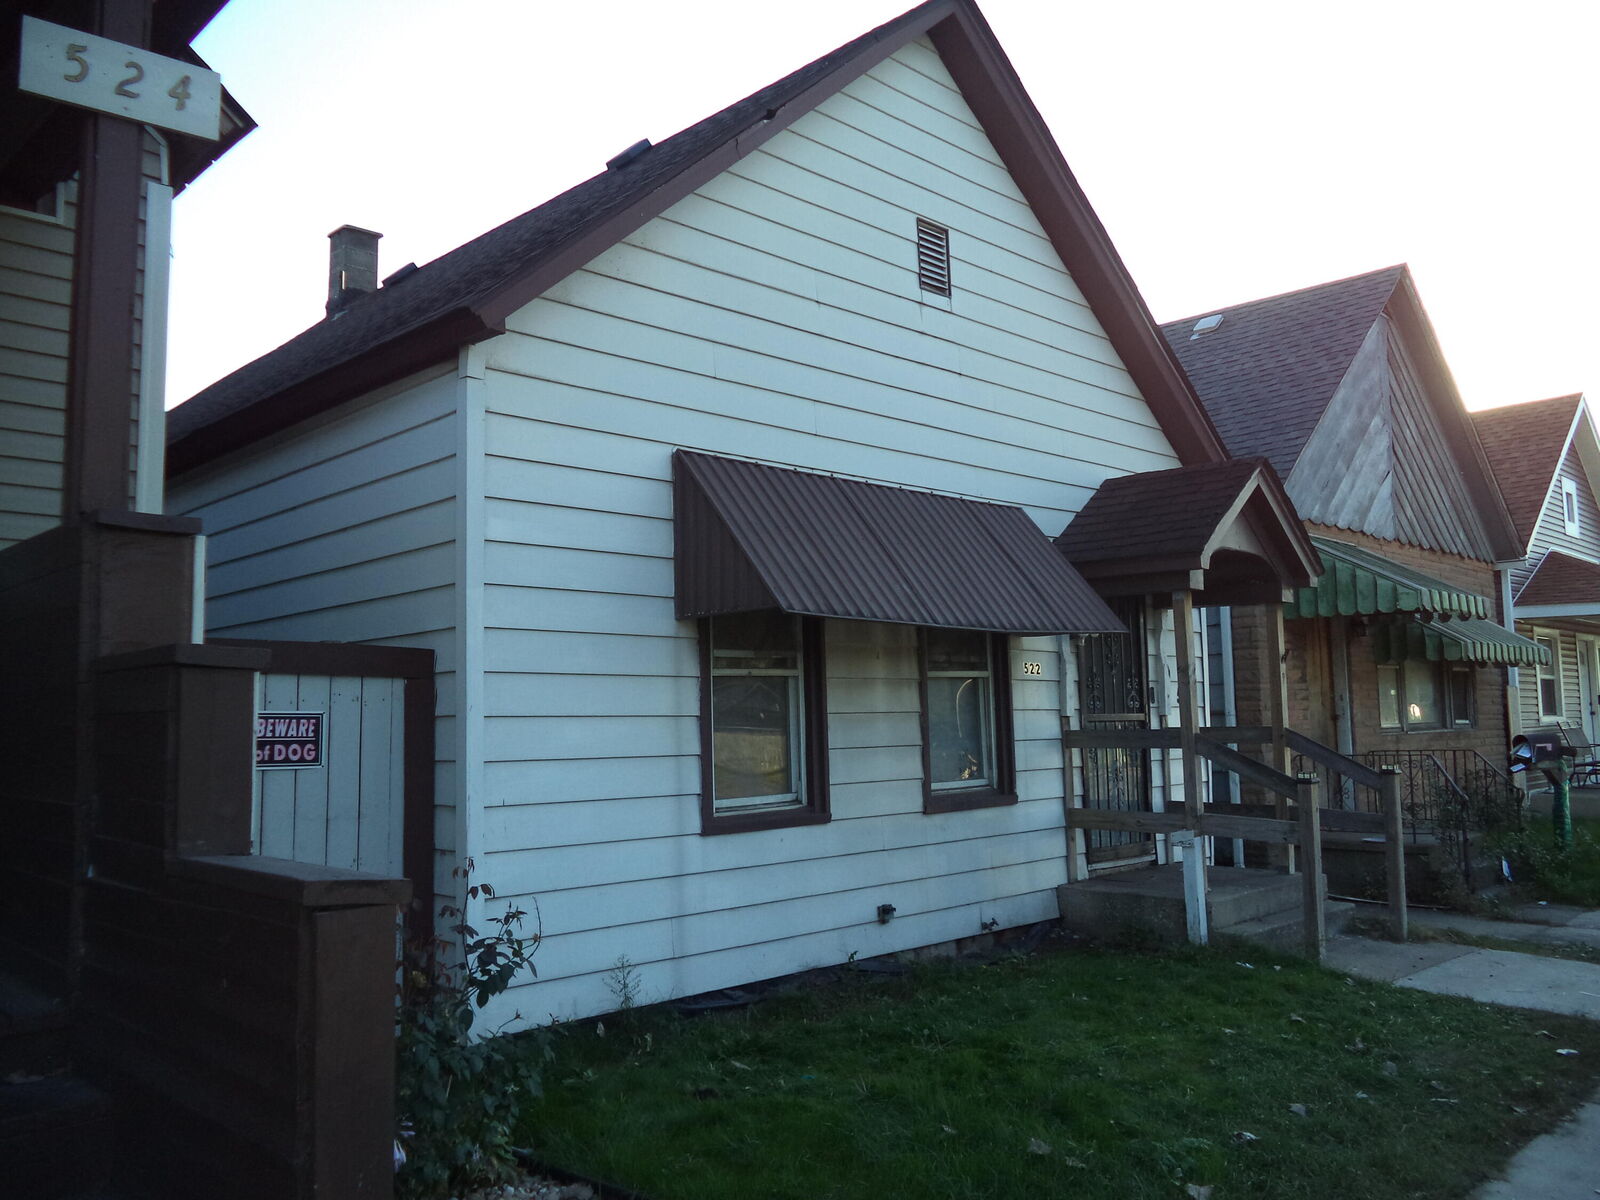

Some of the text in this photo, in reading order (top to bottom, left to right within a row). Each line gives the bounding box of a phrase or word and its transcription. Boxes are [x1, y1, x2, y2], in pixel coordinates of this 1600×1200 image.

[63, 43, 192, 111] 524
[1024, 662, 1041, 675] 522
[257, 719, 316, 737] BEWARE
[273, 743, 316, 761] DOG
